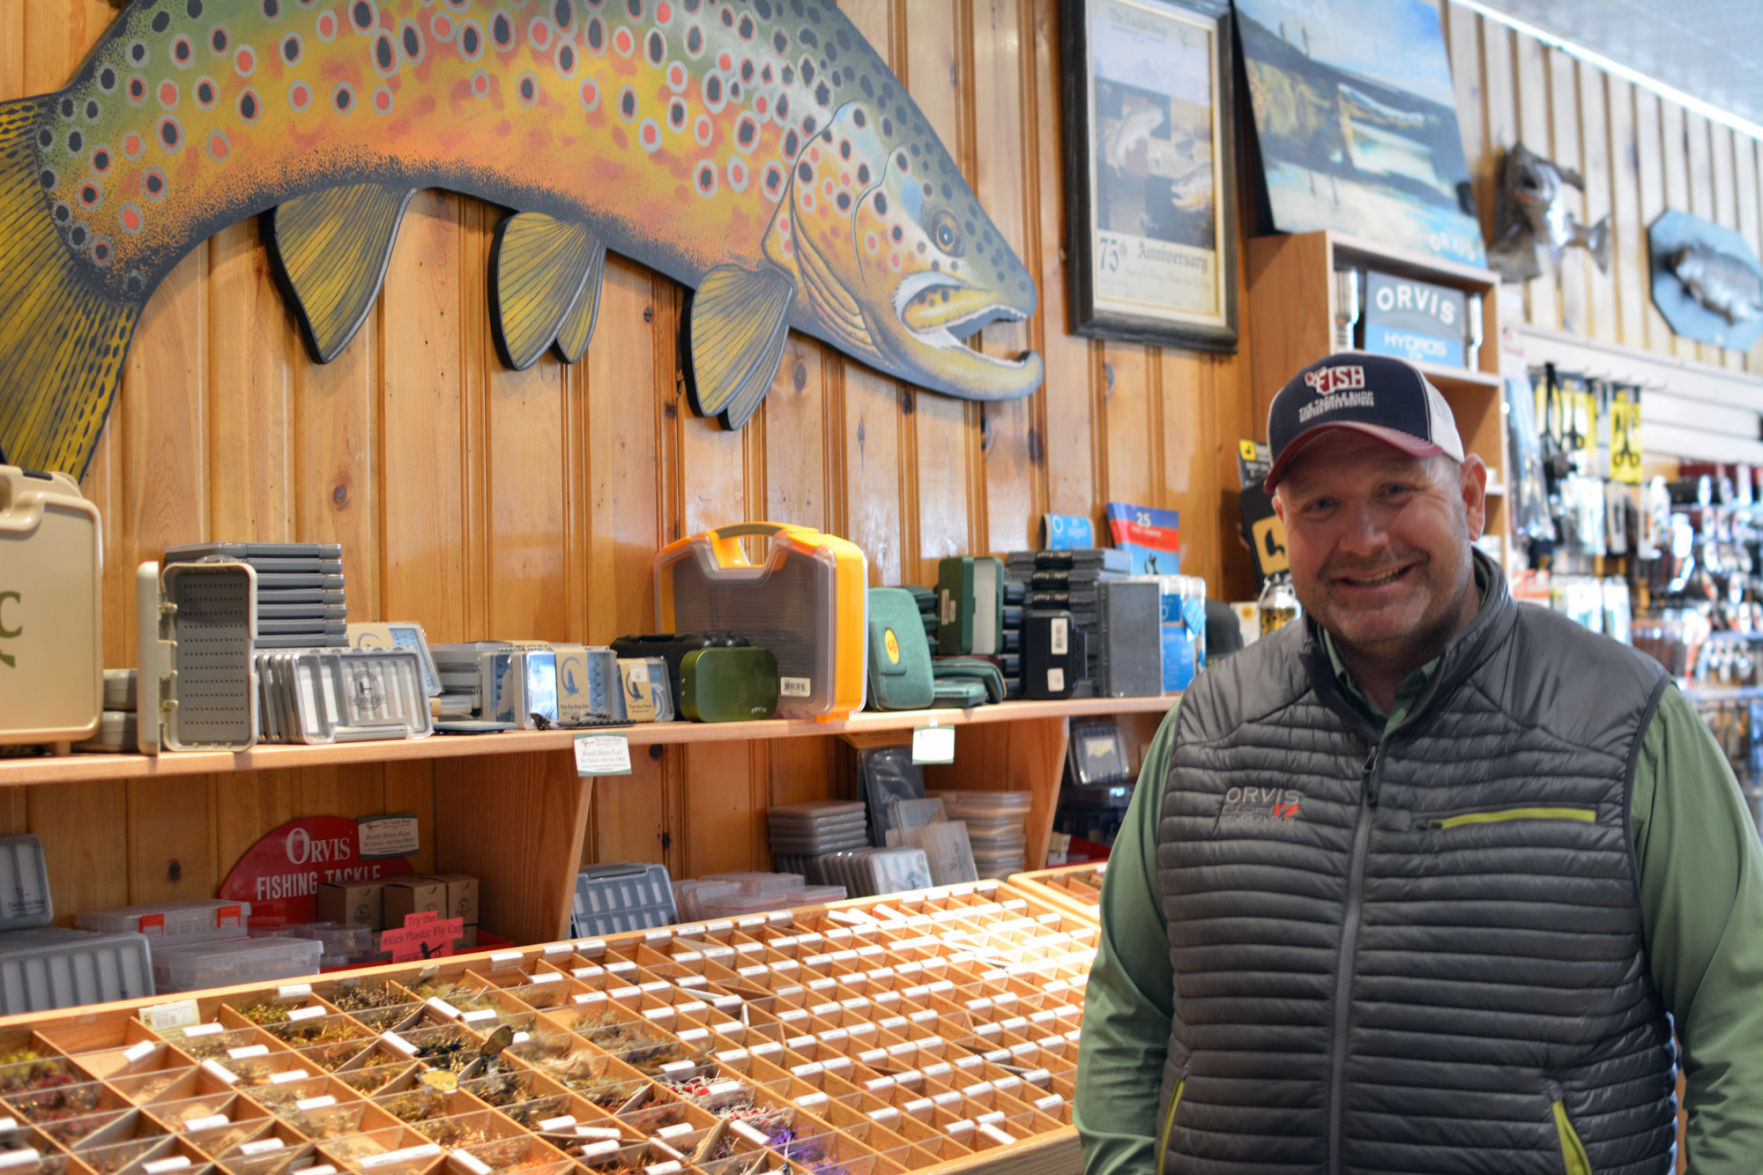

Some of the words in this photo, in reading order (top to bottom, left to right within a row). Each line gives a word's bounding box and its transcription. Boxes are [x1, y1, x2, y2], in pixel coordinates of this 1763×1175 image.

[1137, 239, 1209, 274] Anniversary
[1376, 284, 1456, 325] ORVIS
[1384, 330, 1448, 357] HYDROS
[1136, 511, 1153, 527] 25
[1226, 786, 1304, 805] ORVIS
[257, 871, 318, 901] FISHING
[408, 916, 420, 927] Try
[423, 914, 437, 923] the
[406, 929, 431, 941] Plastic
[433, 925, 446, 937] Fly
